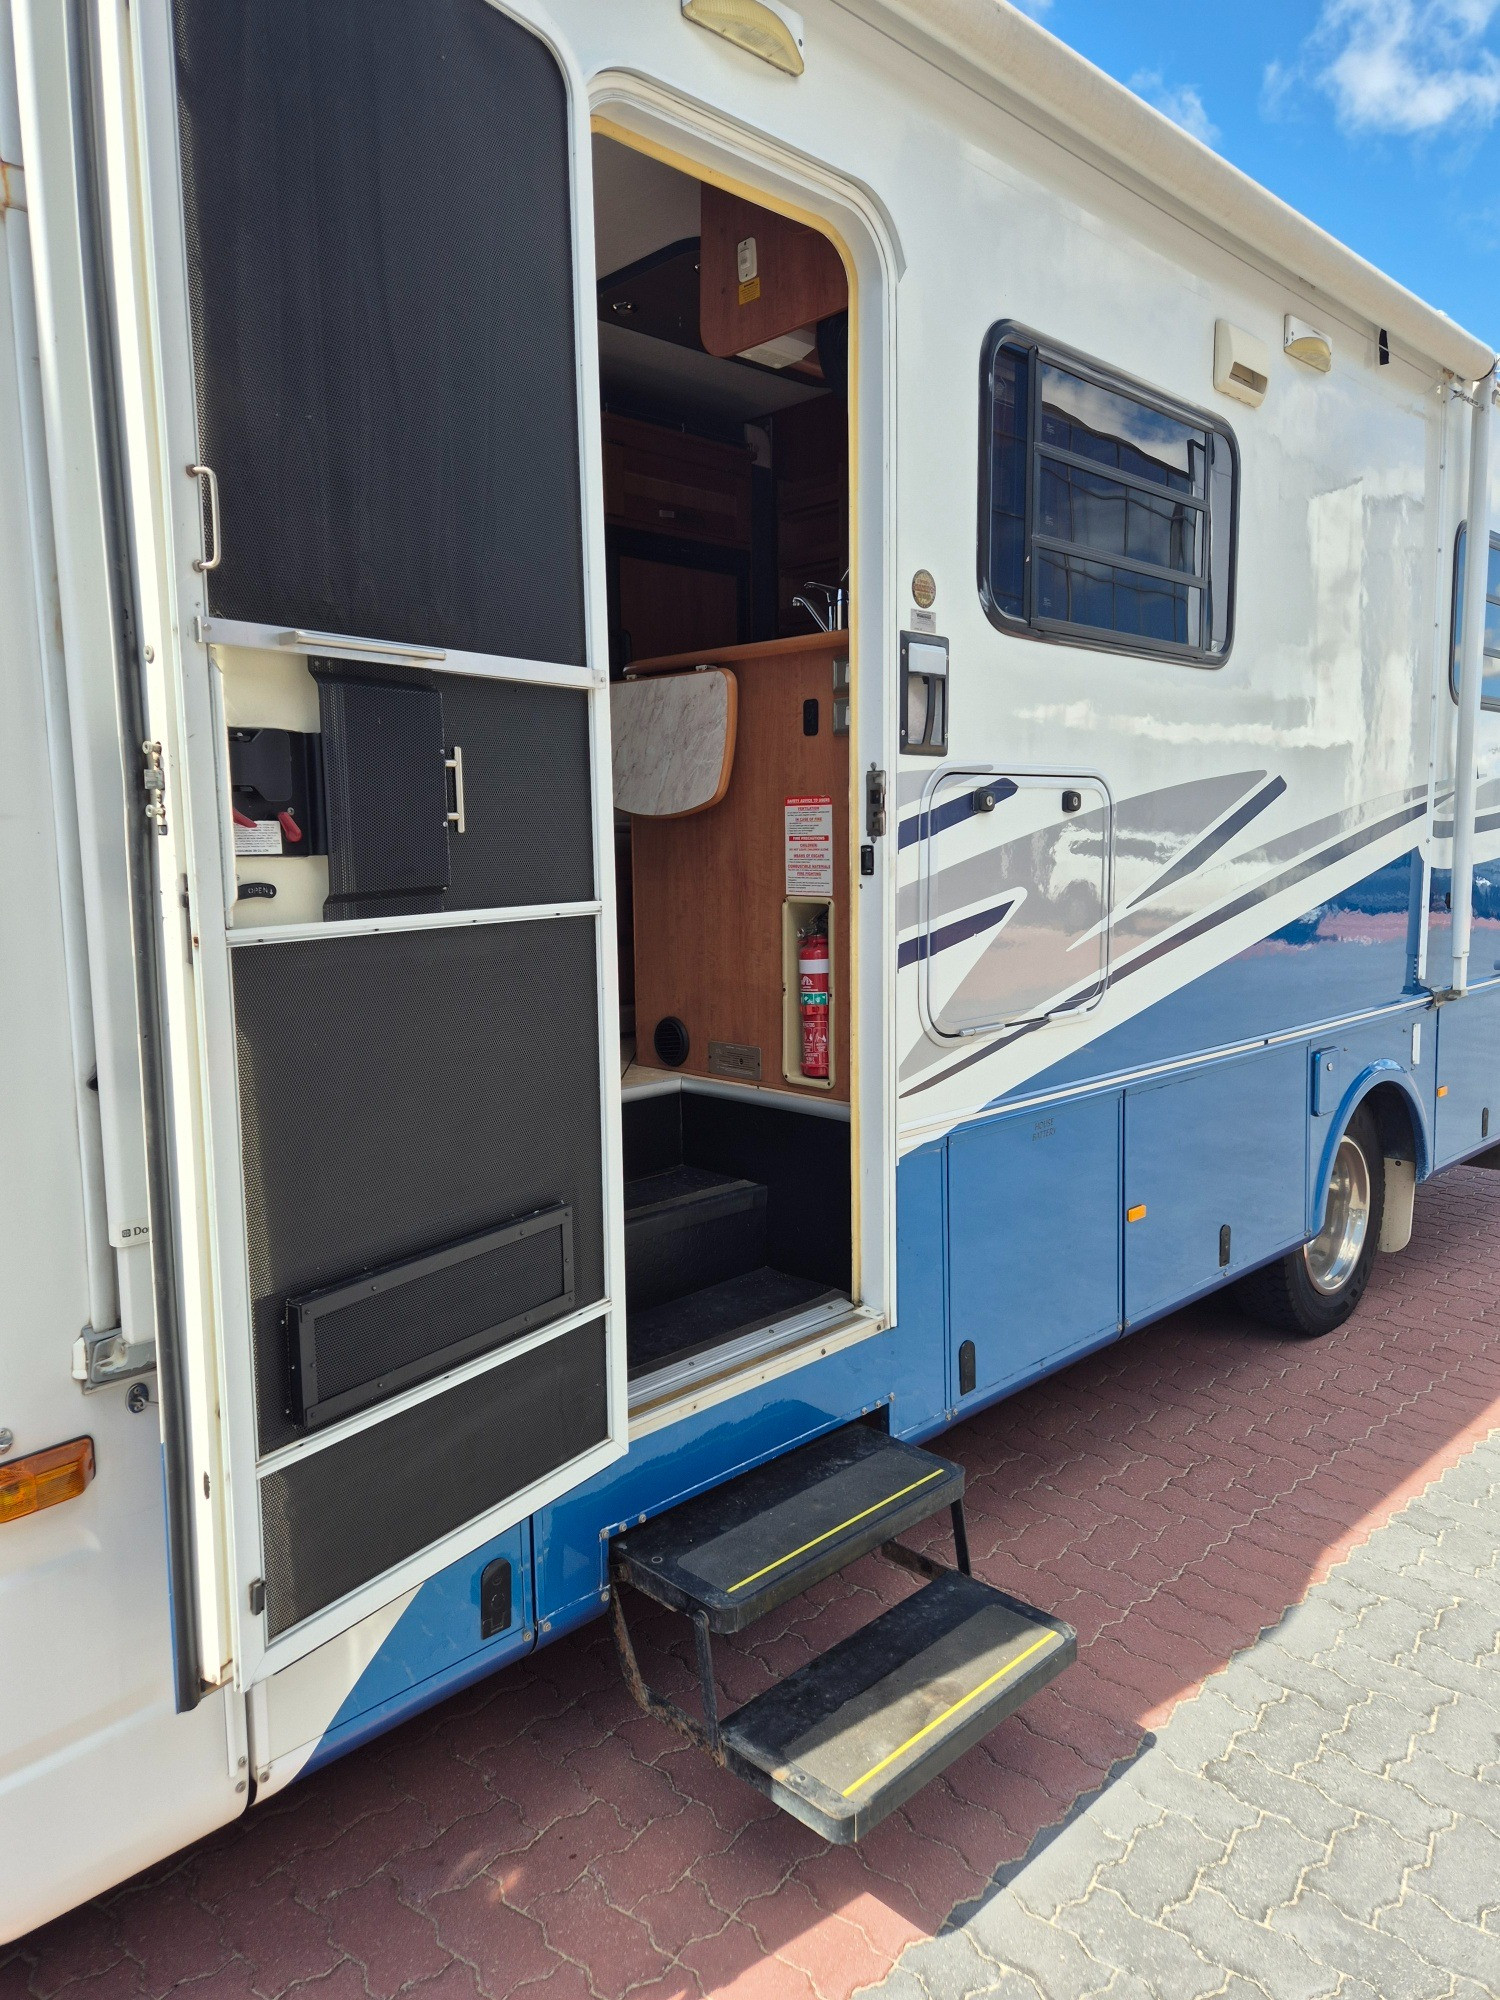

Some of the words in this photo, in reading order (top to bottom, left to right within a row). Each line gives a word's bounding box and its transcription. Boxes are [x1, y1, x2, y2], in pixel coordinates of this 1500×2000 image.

[1034, 1117, 1055, 1130] HOUSE
[1032, 1127, 1056, 1142] BATTERY
[133, 1226, 149, 1236] Do
